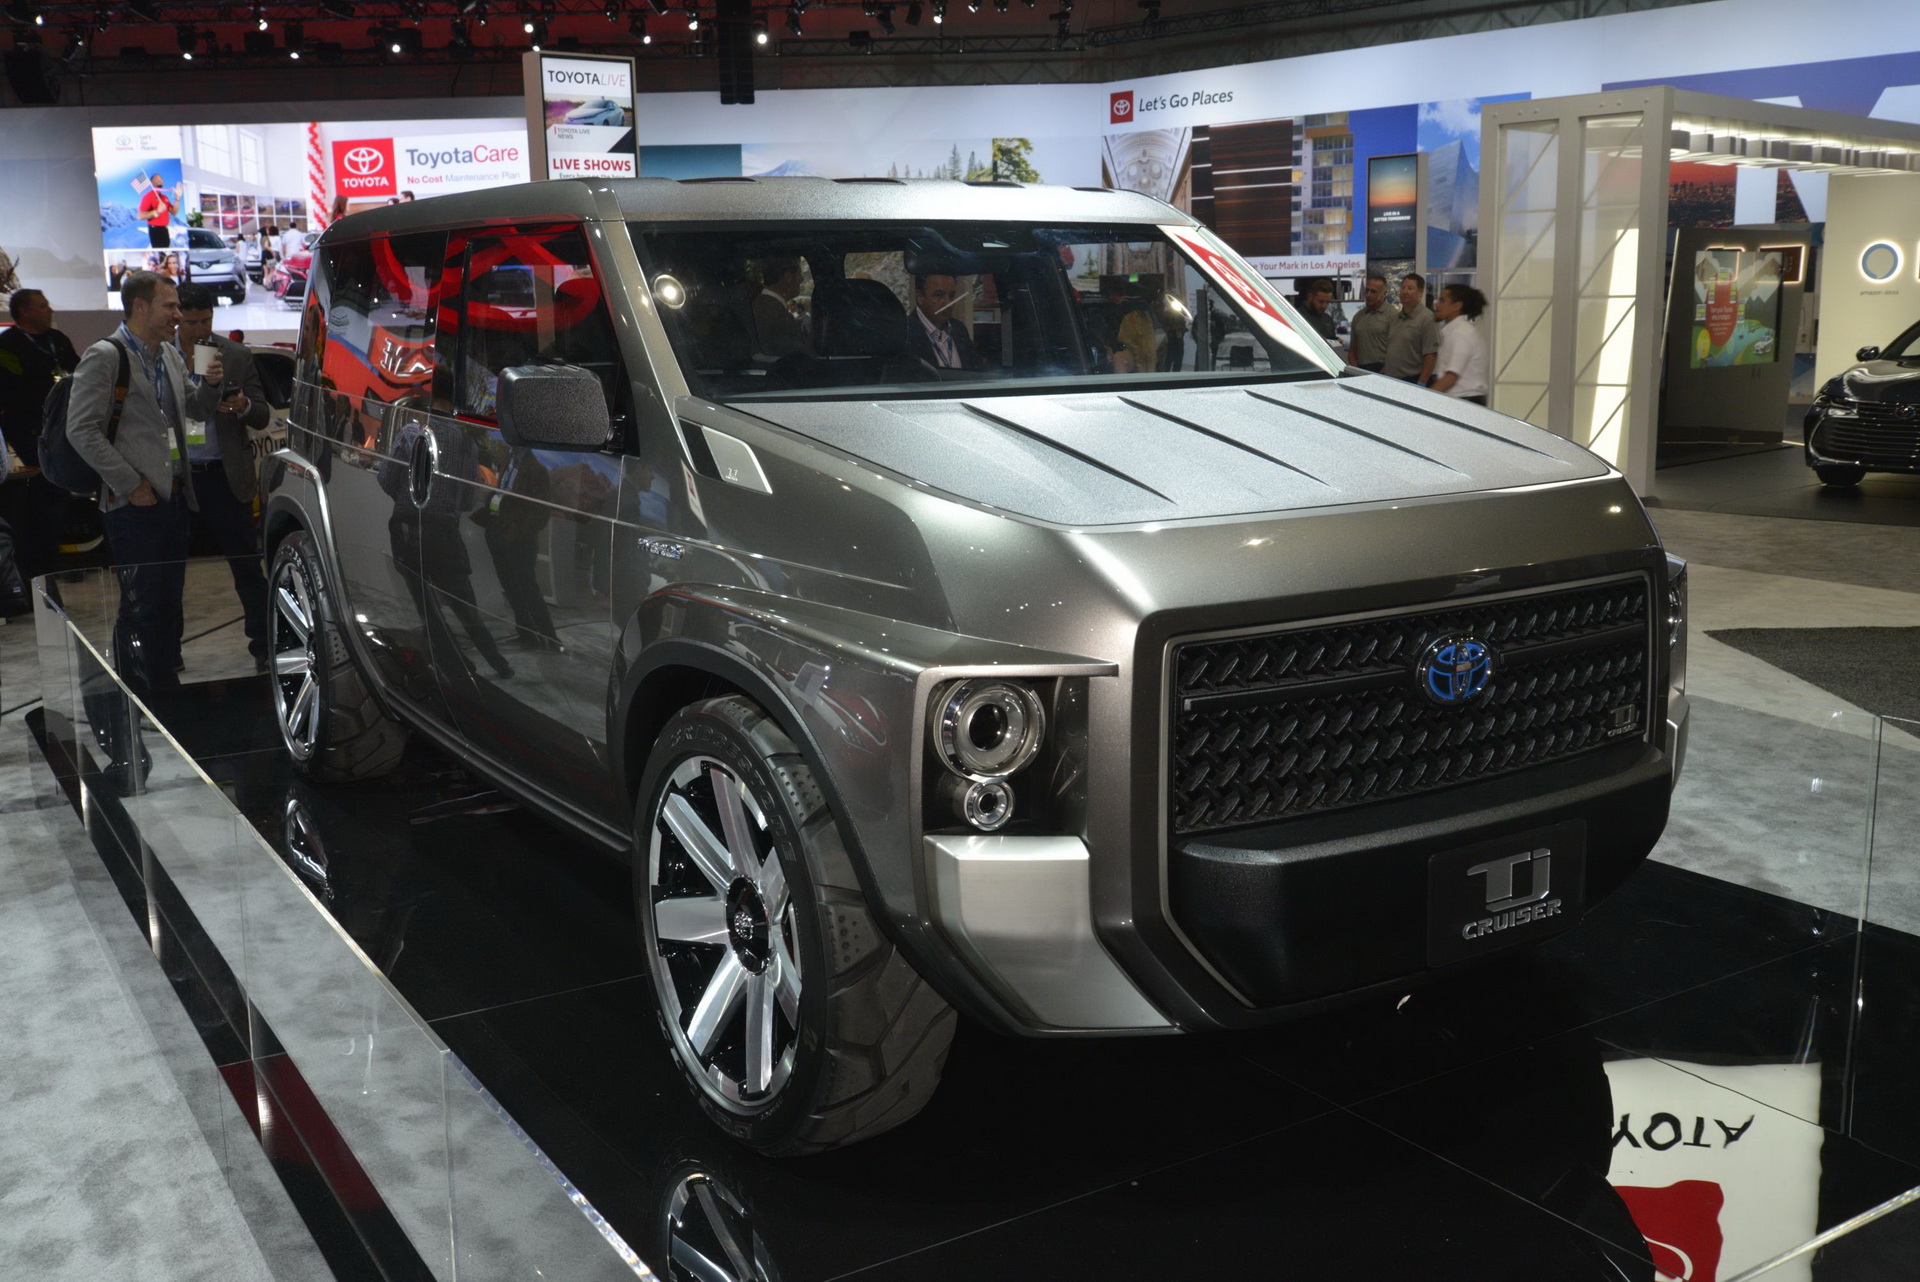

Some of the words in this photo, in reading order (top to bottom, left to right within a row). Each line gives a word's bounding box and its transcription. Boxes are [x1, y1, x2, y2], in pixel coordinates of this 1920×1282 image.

[547, 70, 626, 86] TOYOTALIVE
[1139, 96, 1167, 112] Let's
[1169, 94, 1188, 108] Go
[1191, 90, 1233, 106] Places
[405, 145, 519, 169] ToyotaCare
[553, 158, 580, 170] LIVE
[583, 159, 632, 172] SHOWS
[342, 176, 389, 189] TOYOTA
[407, 176, 420, 184] No
[422, 175, 443, 184] Cost
[445, 172, 499, 183] Maintenance
[501, 171, 521, 180] Plan
[1259, 261, 1277, 270] Your
[1278, 261, 1299, 270] Mark
[1300, 260, 1309, 269] in
[1310, 260, 1324, 269] Los
[1327, 259, 1360, 271] Angeles
[670, 724, 797, 862] BRIDGESTONE
[1462, 899, 1562, 940] CRUISER
